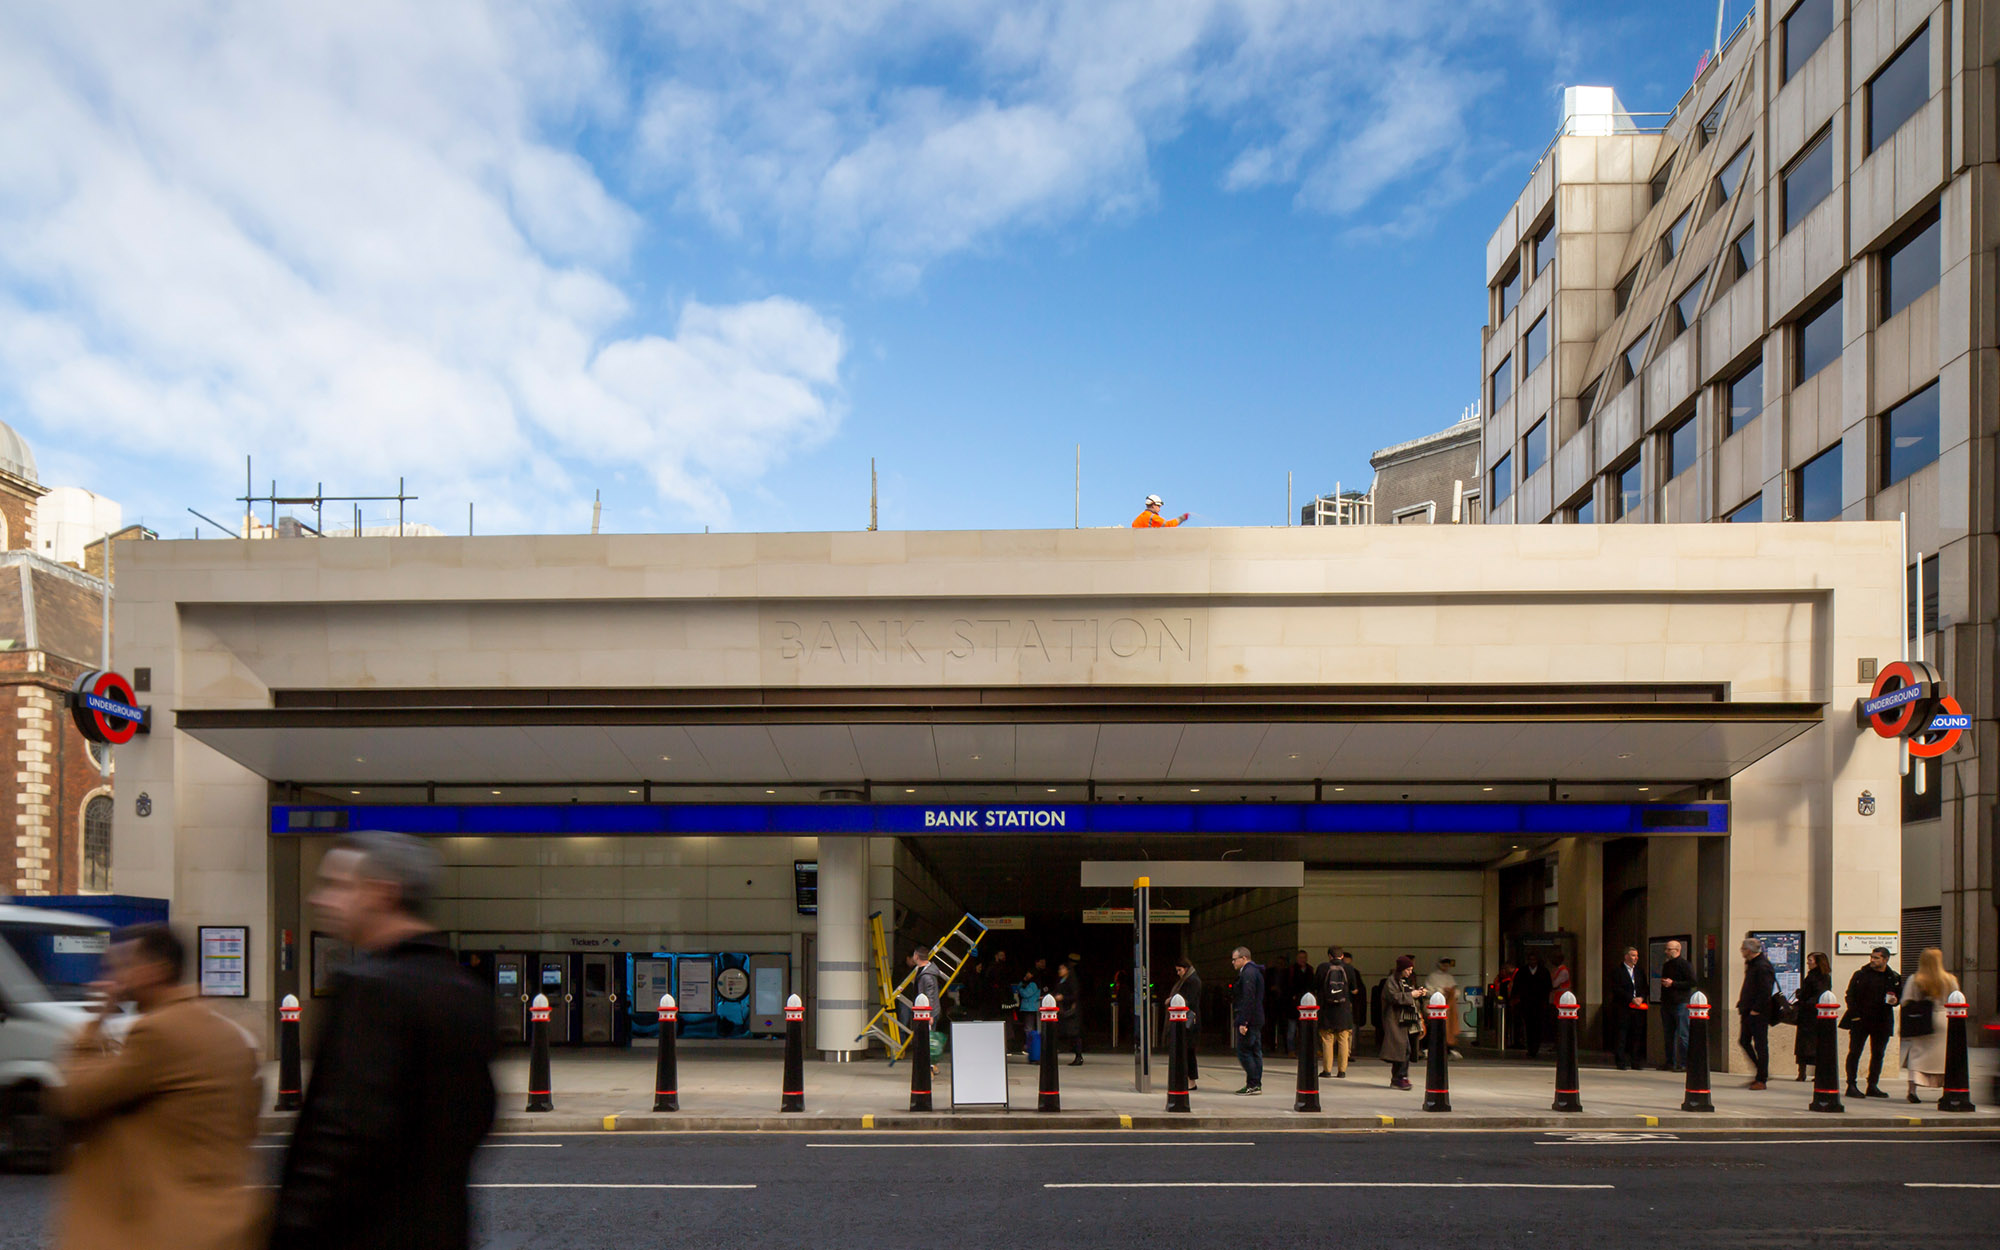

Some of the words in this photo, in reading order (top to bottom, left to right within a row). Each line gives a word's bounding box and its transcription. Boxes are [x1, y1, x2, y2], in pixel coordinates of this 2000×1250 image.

[775, 619, 927, 665] BANK
[946, 617, 1192, 665] STATION
[88, 697, 142, 720] UNDERGROUND
[1866, 687, 1920, 713] UNDERGROUND
[925, 810, 978, 826] BANK
[985, 810, 1066, 826] STATION
[571, 938, 600, 946] Tickets
